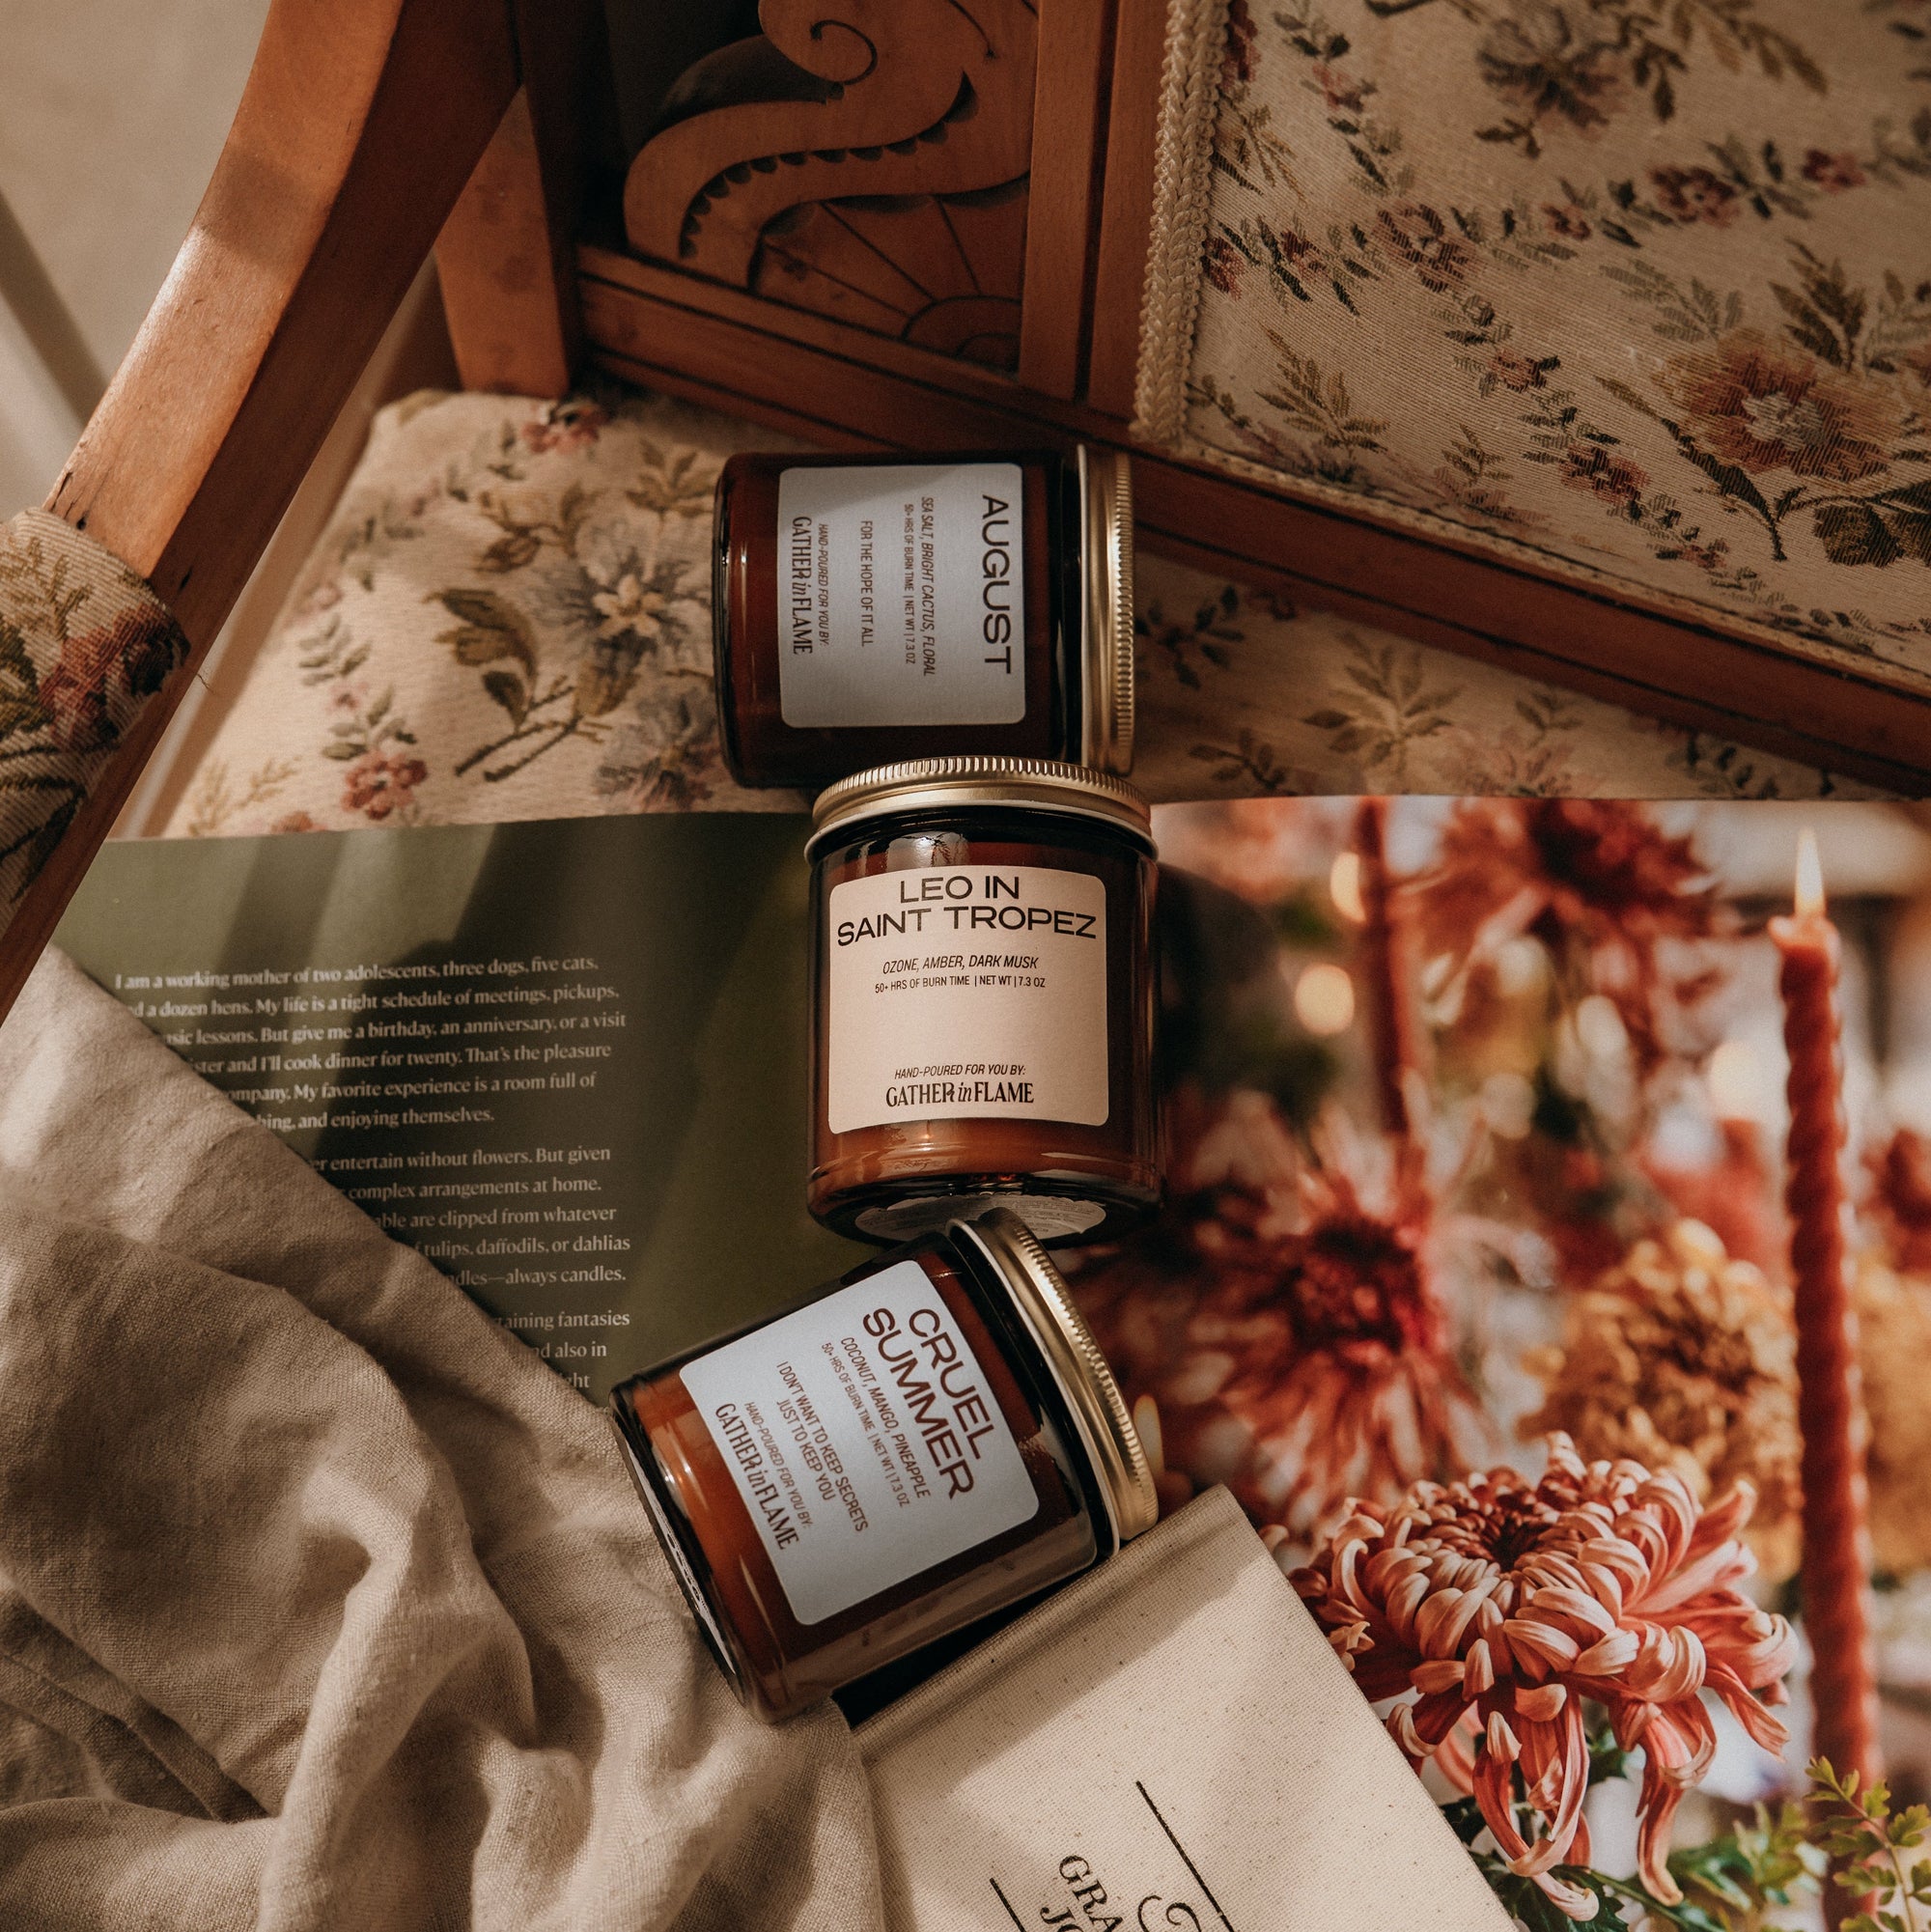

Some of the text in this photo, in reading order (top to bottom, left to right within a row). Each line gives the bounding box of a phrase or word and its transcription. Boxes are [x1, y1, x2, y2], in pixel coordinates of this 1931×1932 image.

[819, 524, 828, 589] HAND-POURED
[792, 516, 813, 655] GATHER in FLAME
[818, 589, 828, 608] FOR
[860, 520, 873, 647] FOR THE HOPE OF IT ALL
[904, 503, 915, 665] 50+ HRS OF BURN TIME NET WT OZ
[919, 496, 936, 677] SEA SALT, BRIGHT CACTUS, FLORAL
[982, 493, 1012, 675] AUGUST
[819, 609, 828, 630] YOU
[900, 875, 1020, 904] LEO IN
[837, 906, 1097, 947] SAINT TROPEZ
[115, 973, 122, 990] I
[125, 975, 150, 990] am
[153, 975, 162, 989] a
[165, 970, 230, 990] working
[233, 968, 292, 985] mother
[293, 966, 311, 983] of
[312, 967, 342, 983] two
[443, 960, 484, 977] three
[532, 956, 559, 972] five
[882, 955, 1039, 974] OZONE, AMBER, DARK MUSK
[875, 975, 1046, 994] 50+ HRS OF BURN TIME NET WT 7.3 OZ
[147, 989, 472, 1017] a dozen My life is a tight schedule of
[261, 1026, 289, 1042] But
[292, 1024, 324, 1045] give
[327, 1027, 352, 1041] me
[354, 1026, 364, 1039] a
[440, 1023, 460, 1035] an
[559, 1017, 577, 1029] or
[579, 1017, 590, 1028] a
[593, 1011, 627, 1027] visit
[227, 1055, 257, 1072] and
[284, 1053, 322, 1071] cook
[324, 1051, 378, 1069] dinner
[380, 1050, 404, 1067] for
[514, 1045, 540, 1061] the
[545, 1043, 611, 1062] pleasure
[894, 1064, 1026, 1079] HAND-POURED FOR YOU BY:
[294, 1071, 598, 1102] My favorite experience is a room full of
[885, 1081, 1034, 1107] GATHER in FLAME
[297, 1106, 495, 1130] and enjoying themselves.
[330, 1154, 404, 1171] entertain
[406, 1151, 468, 1168] without
[472, 1149, 532, 1165] flowers.
[536, 1148, 564, 1163] But
[568, 1147, 611, 1165] given
[348, 1182, 416, 1201] complex
[419, 1179, 529, 1199] arrangements
[533, 1180, 547, 1193] at
[552, 1177, 602, 1192] home.
[409, 1207, 616, 1230] are clipped from whatever
[551, 1235, 630, 1252] or dahlias
[561, 1266, 627, 1282] candles.
[558, 1309, 630, 1328] fantasies
[554, 1341, 607, 1358] also in
[909, 1308, 994, 1460] CRUEL
[840, 1336, 931, 1498] COCONUT, MANGO, PINEAPPLE
[862, 1307, 974, 1499] SUMMER
[822, 1342, 910, 1508] 50+ HRS OF BURN TIME NET WT 7.3 OZ
[744, 1401, 785, 1467] HAND-POURED
[777, 1467, 795, 1488] FOR
[788, 1488, 806, 1510] YOU
[776, 1399, 836, 1501] JUST TO KEEP YOU
[795, 1394, 821, 1426] WANT
[812, 1425, 828, 1444] TO
[820, 1443, 844, 1475] KEEP
[835, 1476, 868, 1532] SECRETS
[714, 1403, 799, 1551] GATHER in FLAME
[1058, 1855, 1124, 1932] GRA
